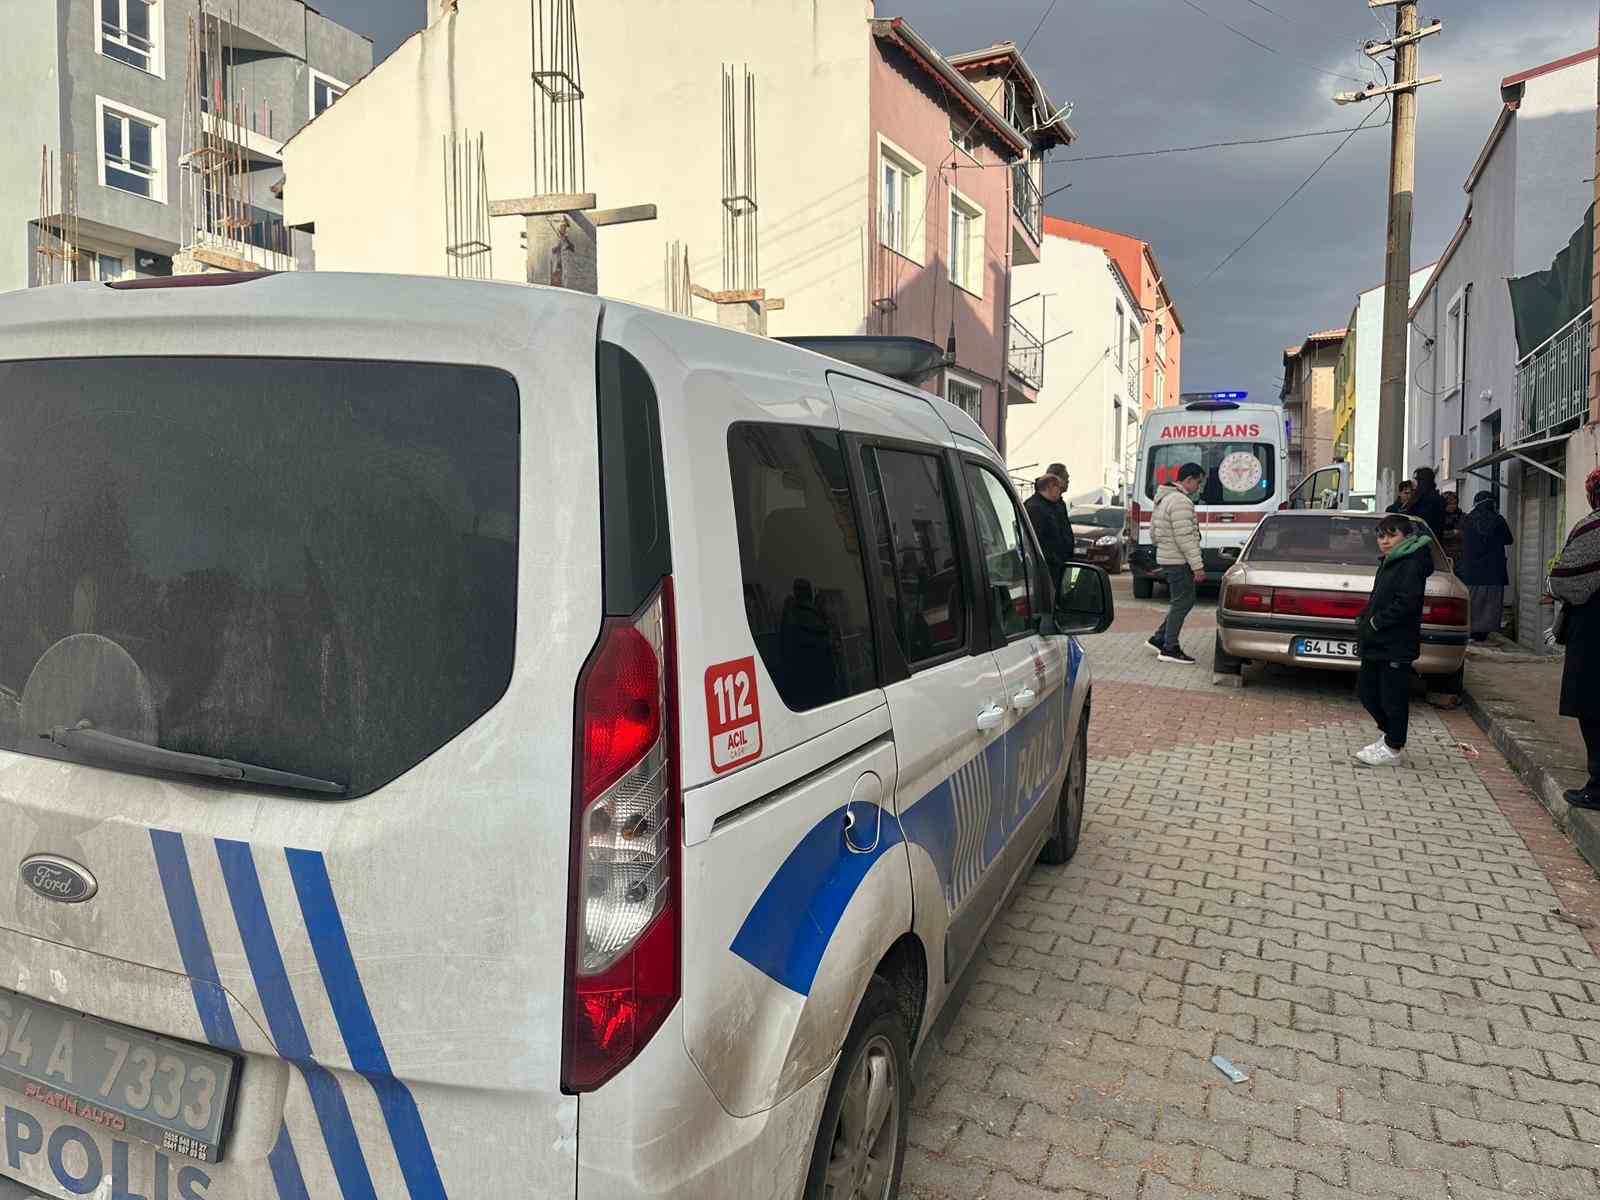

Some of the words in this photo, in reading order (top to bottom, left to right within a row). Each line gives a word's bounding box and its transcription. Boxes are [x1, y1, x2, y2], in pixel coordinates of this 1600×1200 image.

[1160, 424, 1260, 438] AMBULANS
[1305, 641, 1321, 653] 64
[1326, 642, 1347, 655] LS
[1351, 643, 1360, 656] 8
[713, 671, 752, 724] 112
[33, 866, 71, 894] Ford
[45, 1019, 73, 1081] A
[98, 1037, 216, 1130] 7333
[80, 1104, 125, 1131] AUTO
